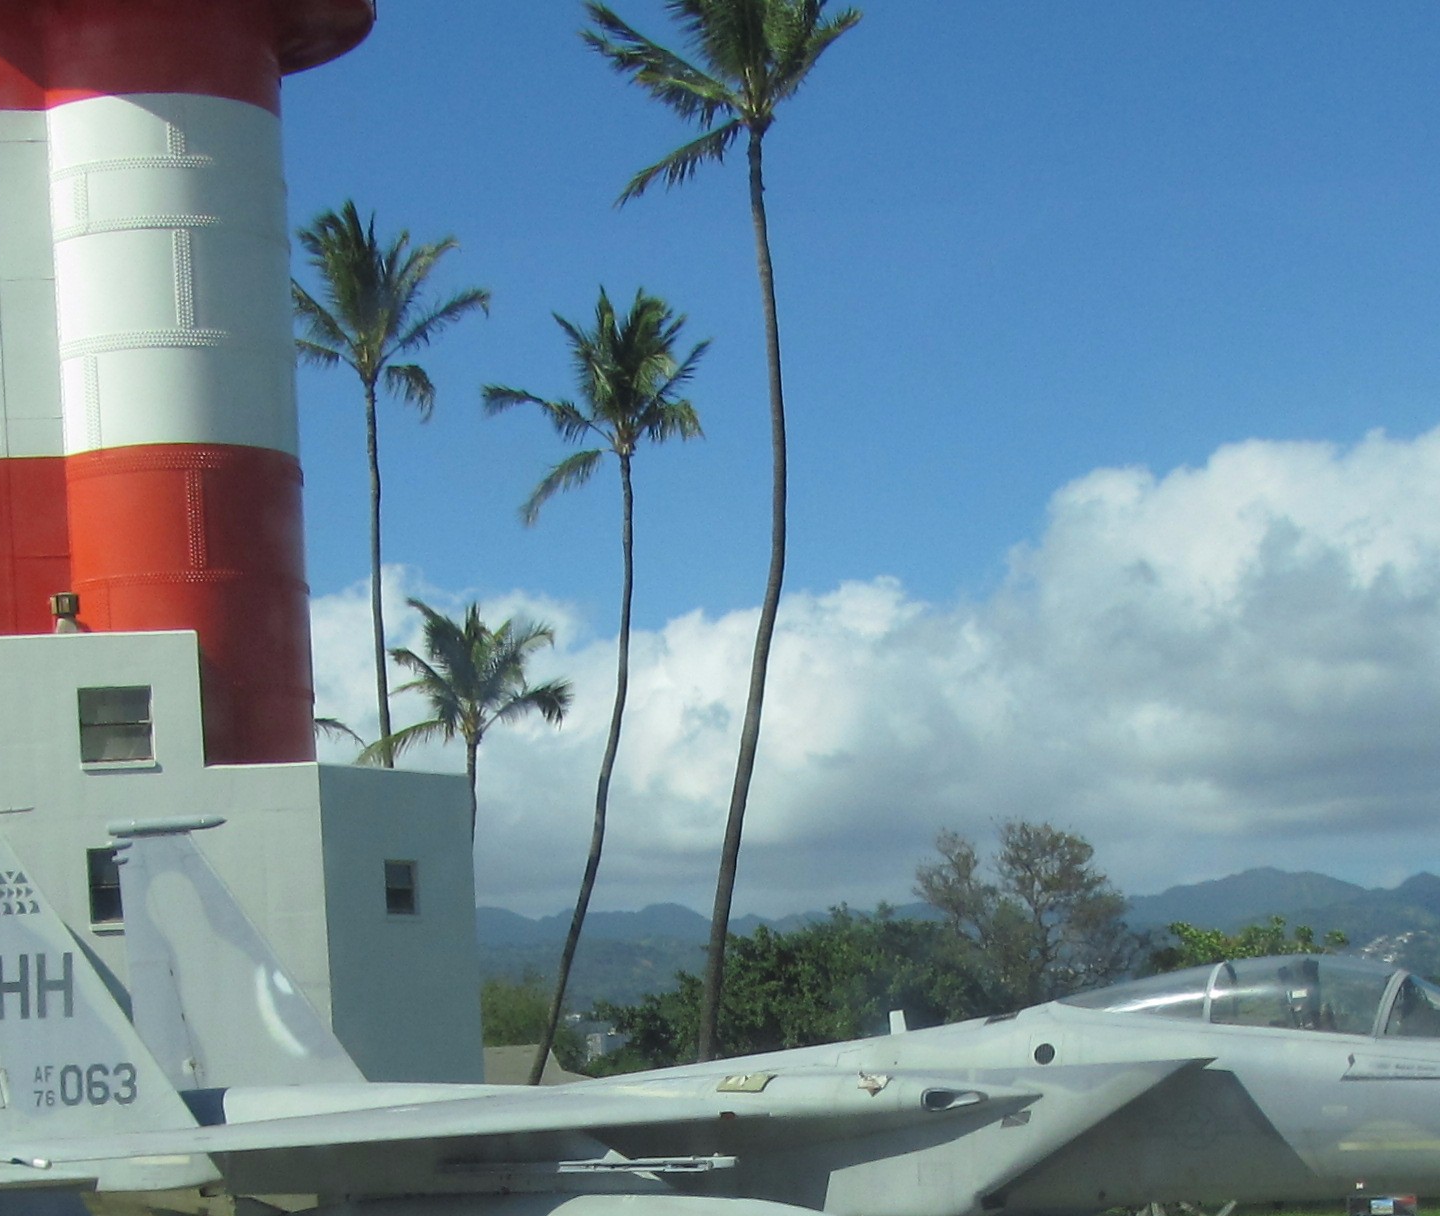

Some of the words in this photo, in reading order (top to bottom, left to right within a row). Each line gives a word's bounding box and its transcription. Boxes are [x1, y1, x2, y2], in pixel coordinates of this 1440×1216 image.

[34, 1065, 54, 1082] AF
[60, 1063, 137, 1106] 063
[34, 1090, 55, 1107] 76
